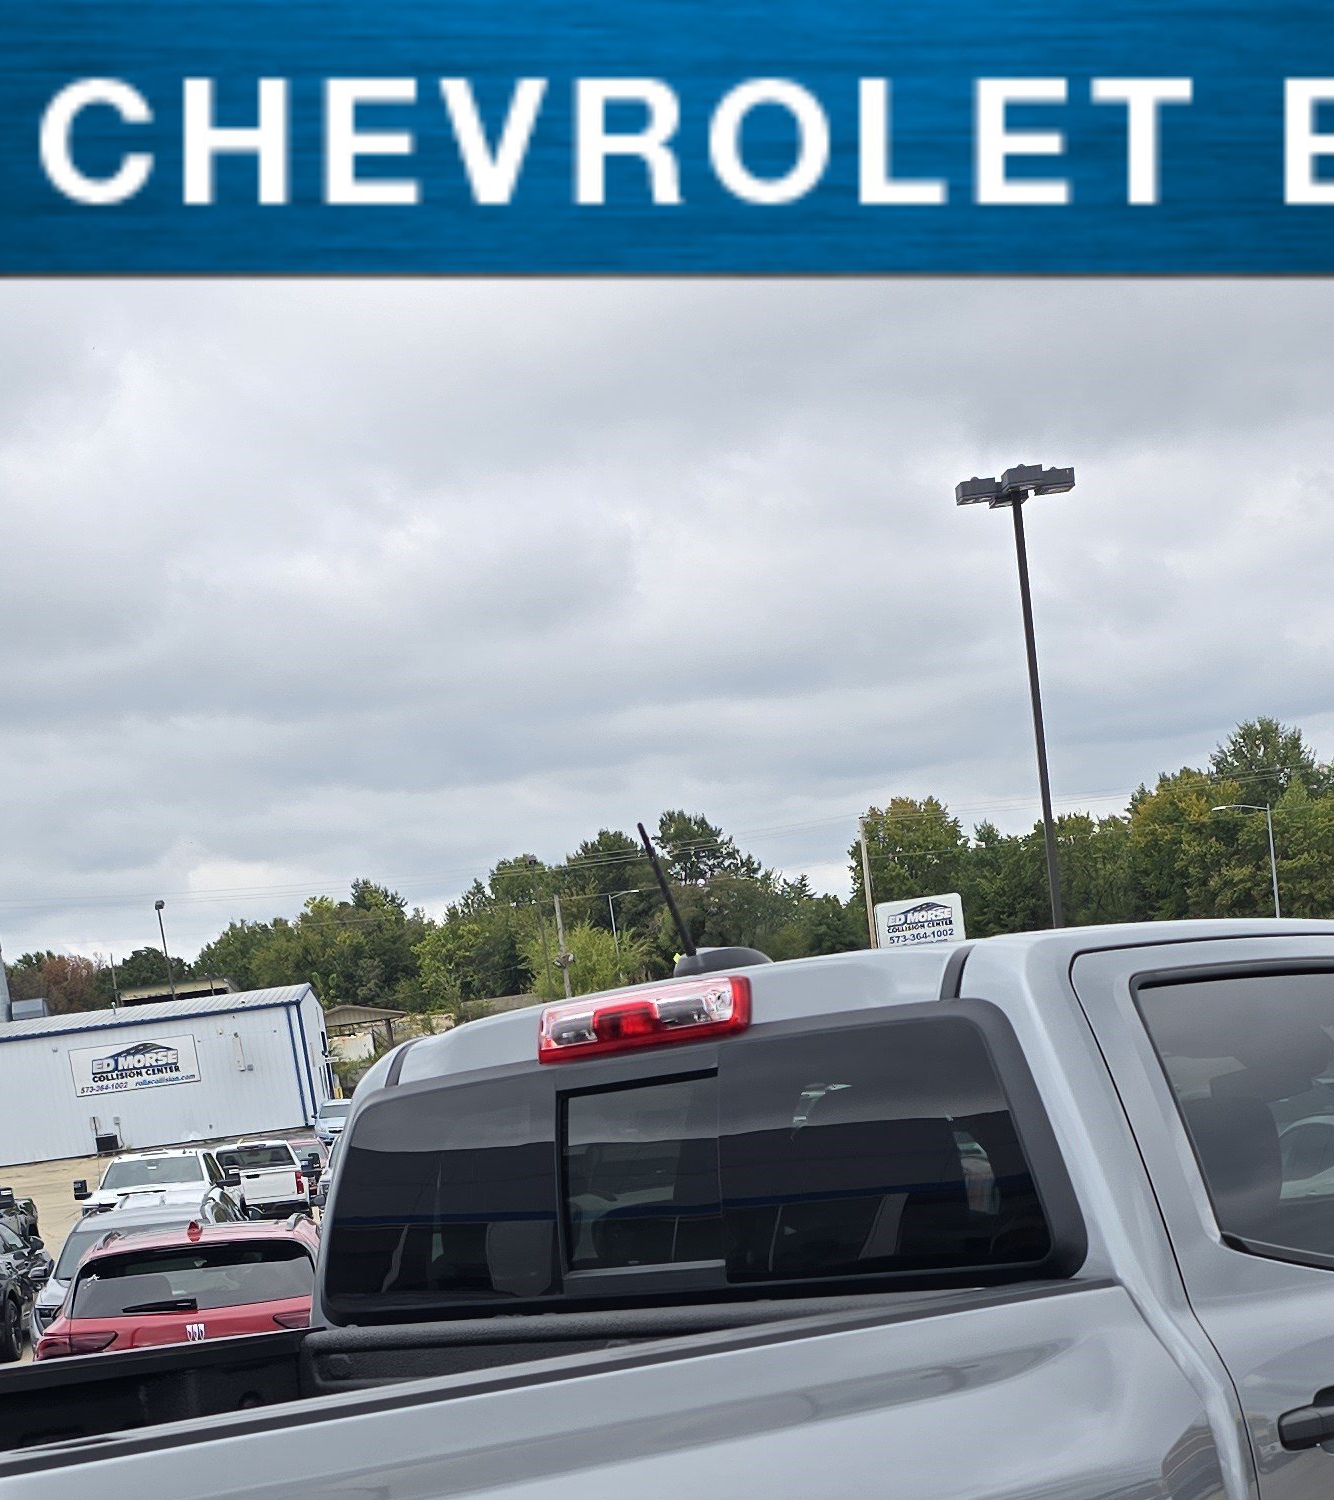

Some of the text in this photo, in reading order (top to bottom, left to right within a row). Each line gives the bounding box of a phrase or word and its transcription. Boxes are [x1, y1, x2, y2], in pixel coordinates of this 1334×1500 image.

[887, 906, 953, 927] ED MORSE
[887, 919, 954, 934] COLLISION CENTER
[889, 928, 954, 944] 573-364-1002
[92, 1049, 178, 1075] ED MORSE
[92, 1065, 181, 1083] COLLISION CENTER
[80, 1081, 128, 1094] 573-364-1002
